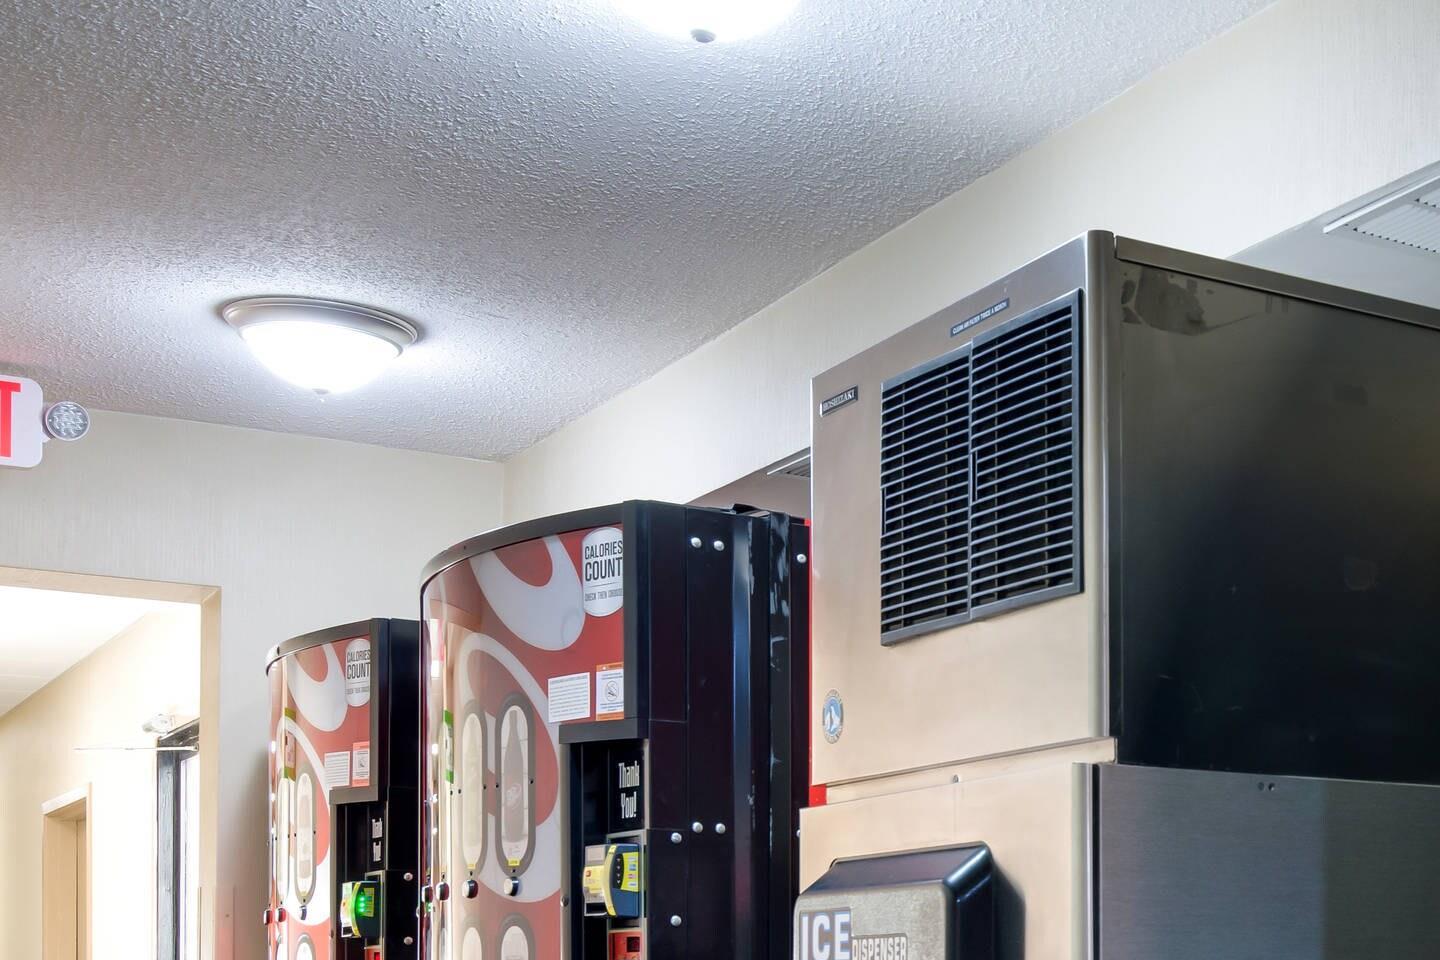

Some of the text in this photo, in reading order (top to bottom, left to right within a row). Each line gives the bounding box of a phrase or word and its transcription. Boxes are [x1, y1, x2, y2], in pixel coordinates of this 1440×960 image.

[585, 541, 623, 560] CALORIES
[585, 557, 623, 582] COUNT
[347, 650, 370, 663] CALORIES
[347, 662, 370, 679] COUNT
[618, 760, 640, 789] Thank
[621, 791, 637, 819] You!
